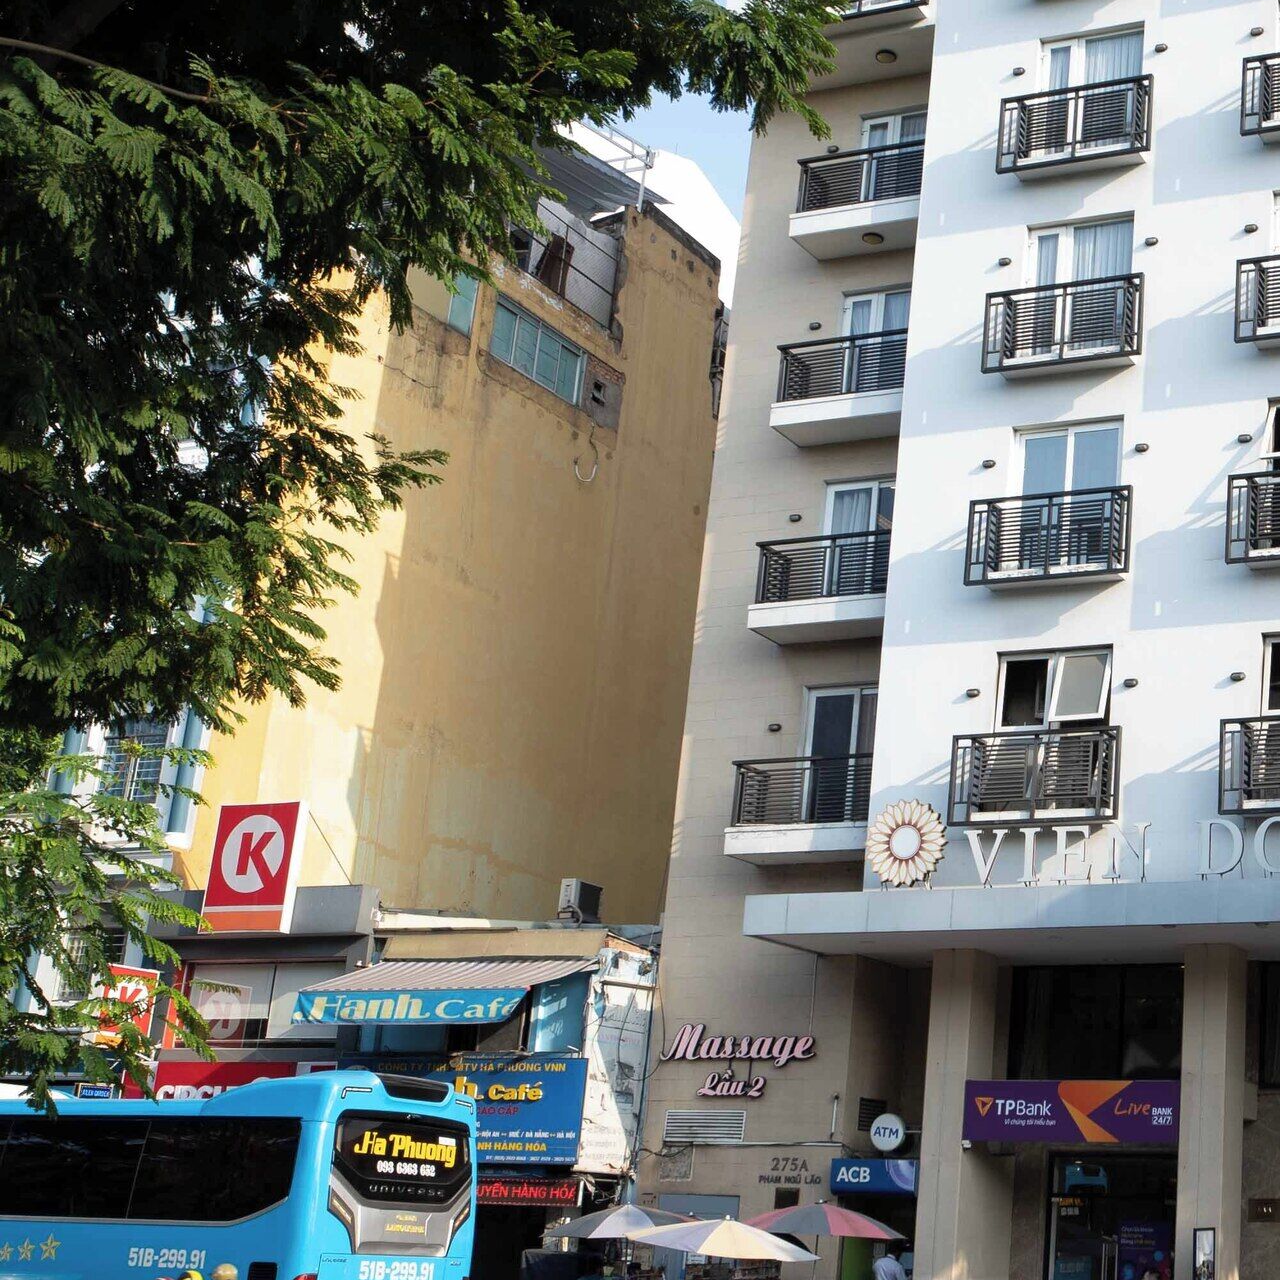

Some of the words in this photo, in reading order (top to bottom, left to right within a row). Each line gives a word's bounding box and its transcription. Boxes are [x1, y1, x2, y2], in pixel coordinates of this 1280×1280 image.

[235, 831, 278, 887] K
[963, 821, 1152, 885] VIEN
[293, 993, 431, 1021] Hanh
[434, 996, 523, 1019] Café
[659, 1023, 817, 1067] Massage
[543, 1062, 567, 1072] VNN
[487, 1081, 544, 1101] Café
[697, 1069, 746, 1096] Lầu
[748, 1076, 767, 1098] 2
[995, 1098, 1052, 1116] TPBank
[1114, 1098, 1151, 1116] Live
[1151, 1107, 1173, 1116] BANK
[1152, 1116, 1173, 1125] 24/7
[873, 1125, 899, 1139] ATM
[353, 1131, 387, 1156] Ha
[376, 1160, 394, 1174] 093
[771, 1157, 809, 1172] 275A
[836, 1166, 871, 1183] ACB
[511, 1183, 548, 1199] HÀNG
[128, 1247, 207, 1270] 51B-299.91
